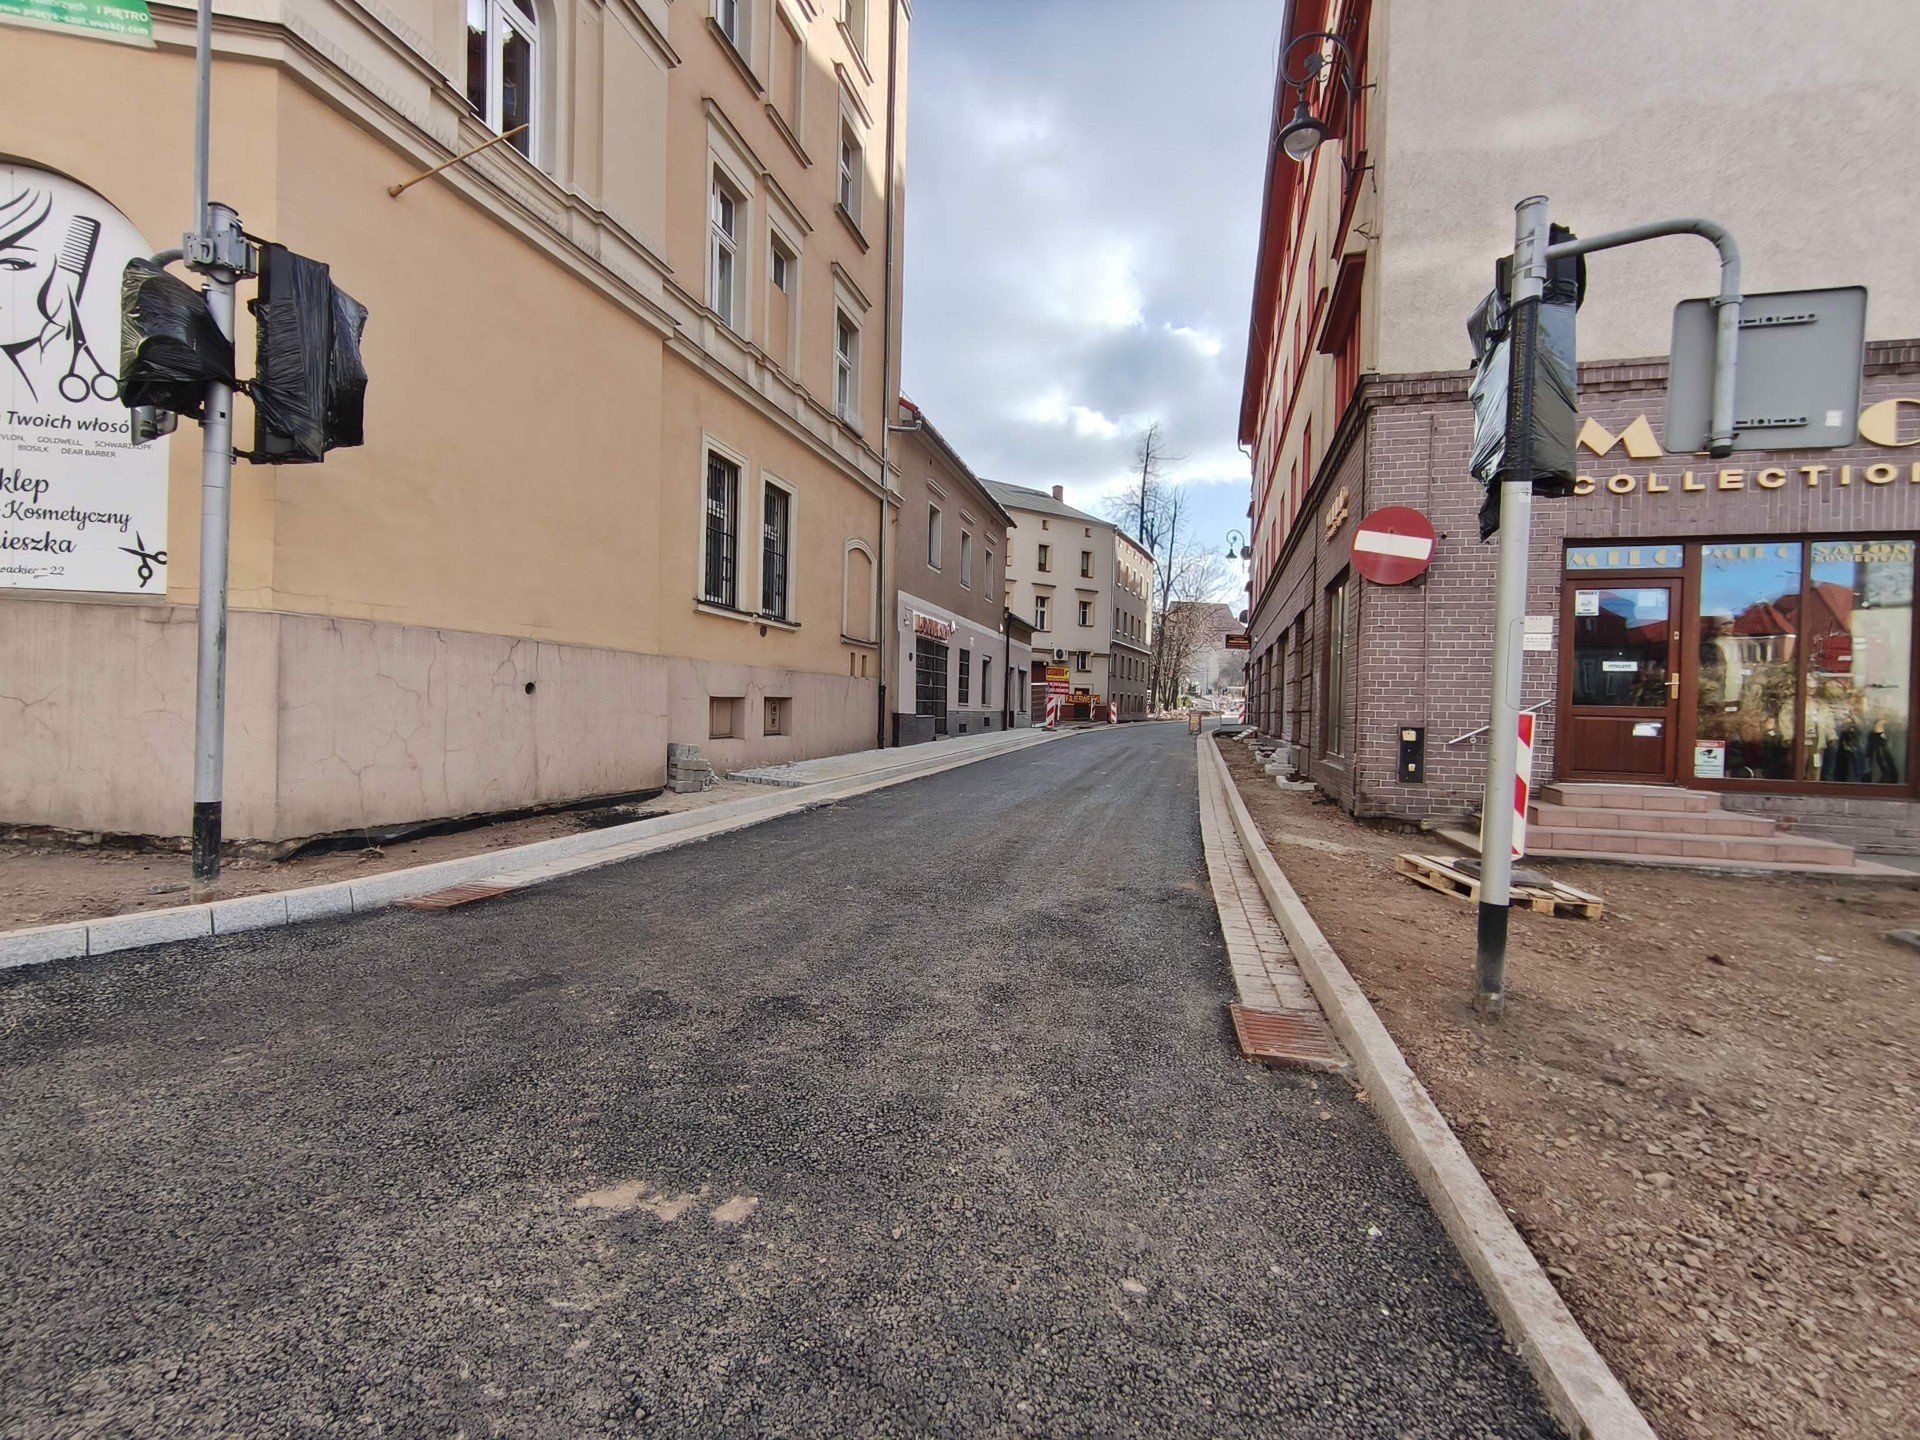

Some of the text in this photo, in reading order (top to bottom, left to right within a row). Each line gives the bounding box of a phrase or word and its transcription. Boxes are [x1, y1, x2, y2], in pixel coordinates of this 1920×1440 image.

[7, 411, 130, 434] Twoich włosó
[0, 433, 25, 442] VLON,
[61, 447, 83, 456] DEAR
[84, 449, 116, 458] BARBER
[2, 500, 132, 533] Kosmetyczny
[0, 530, 77, 555] ieszka
[1570, 549, 1683, 566] MILO
